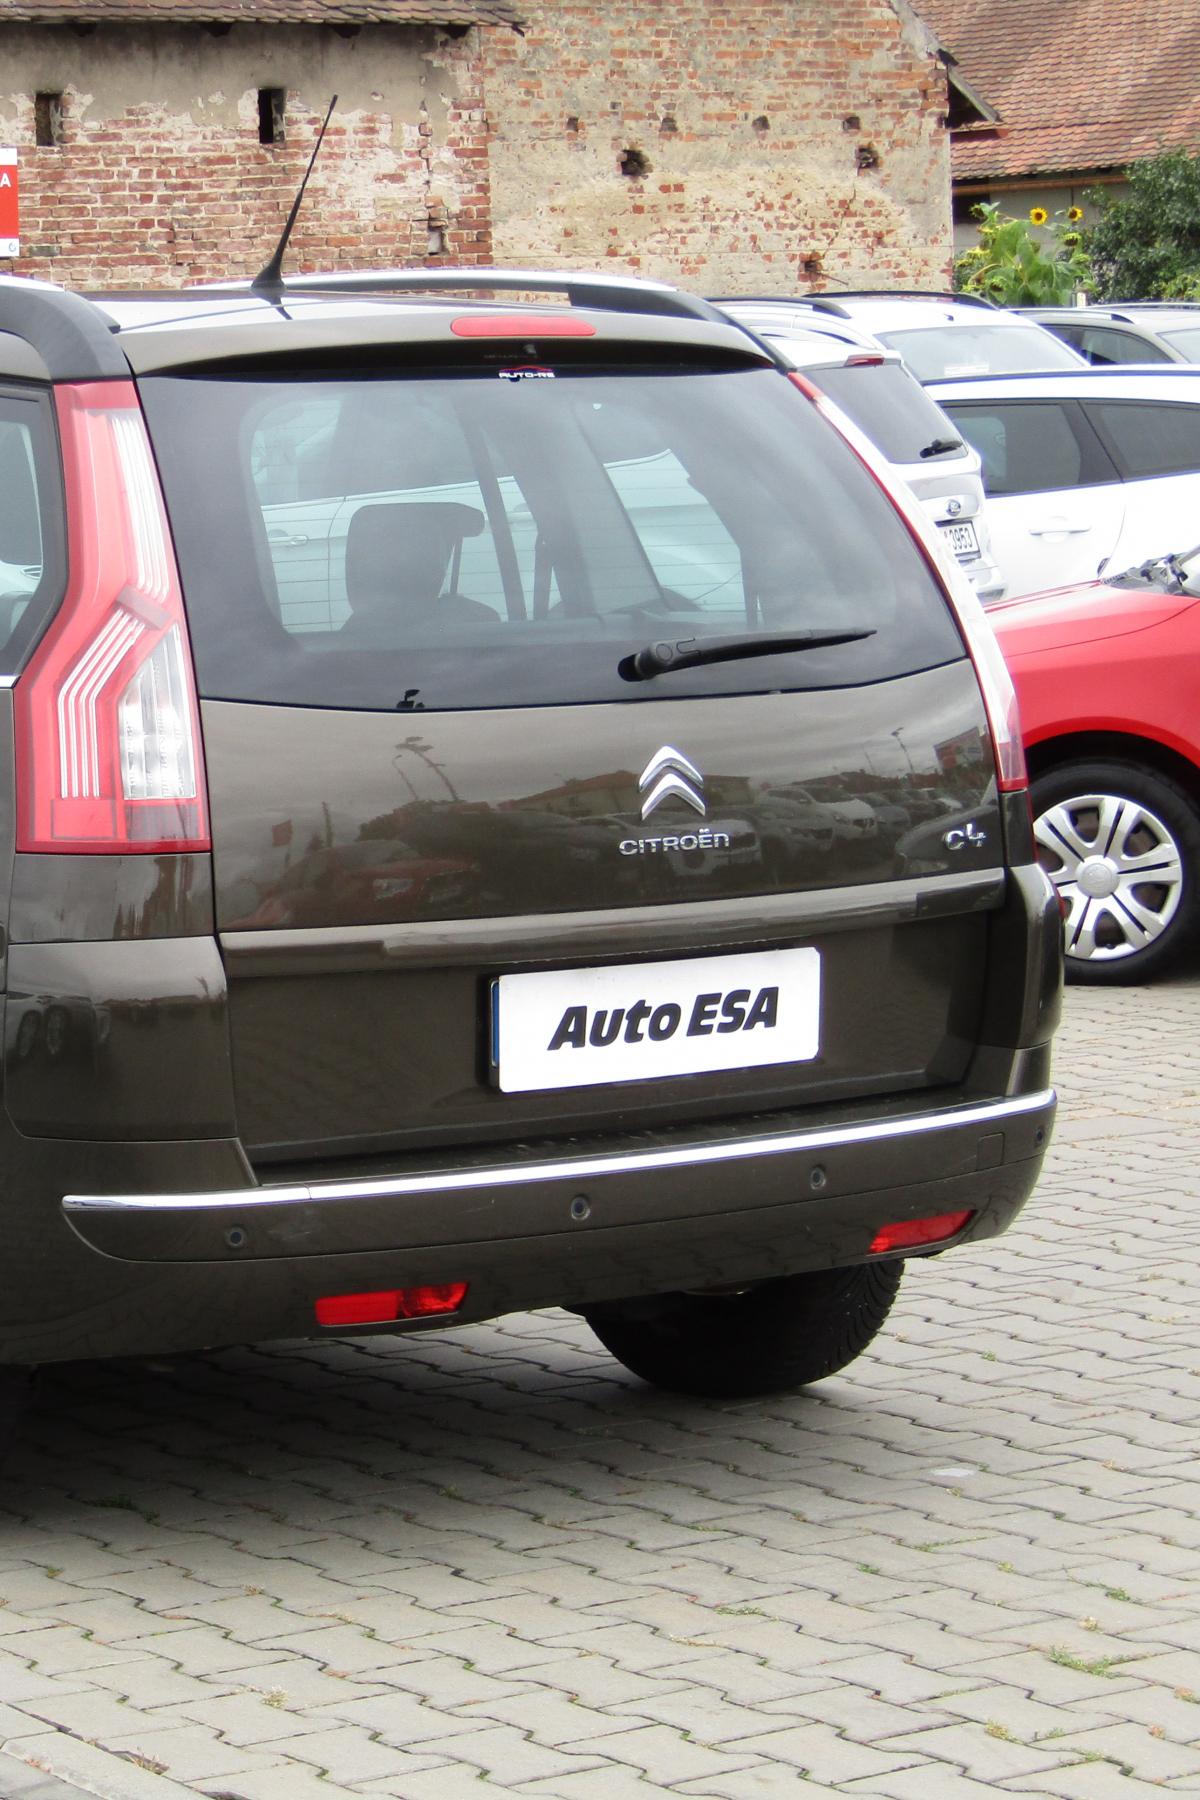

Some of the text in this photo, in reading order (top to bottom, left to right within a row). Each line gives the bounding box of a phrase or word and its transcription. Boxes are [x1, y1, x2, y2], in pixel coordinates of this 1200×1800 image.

[945, 823, 987, 851] C4
[547, 986, 780, 1051] Auto ESA
